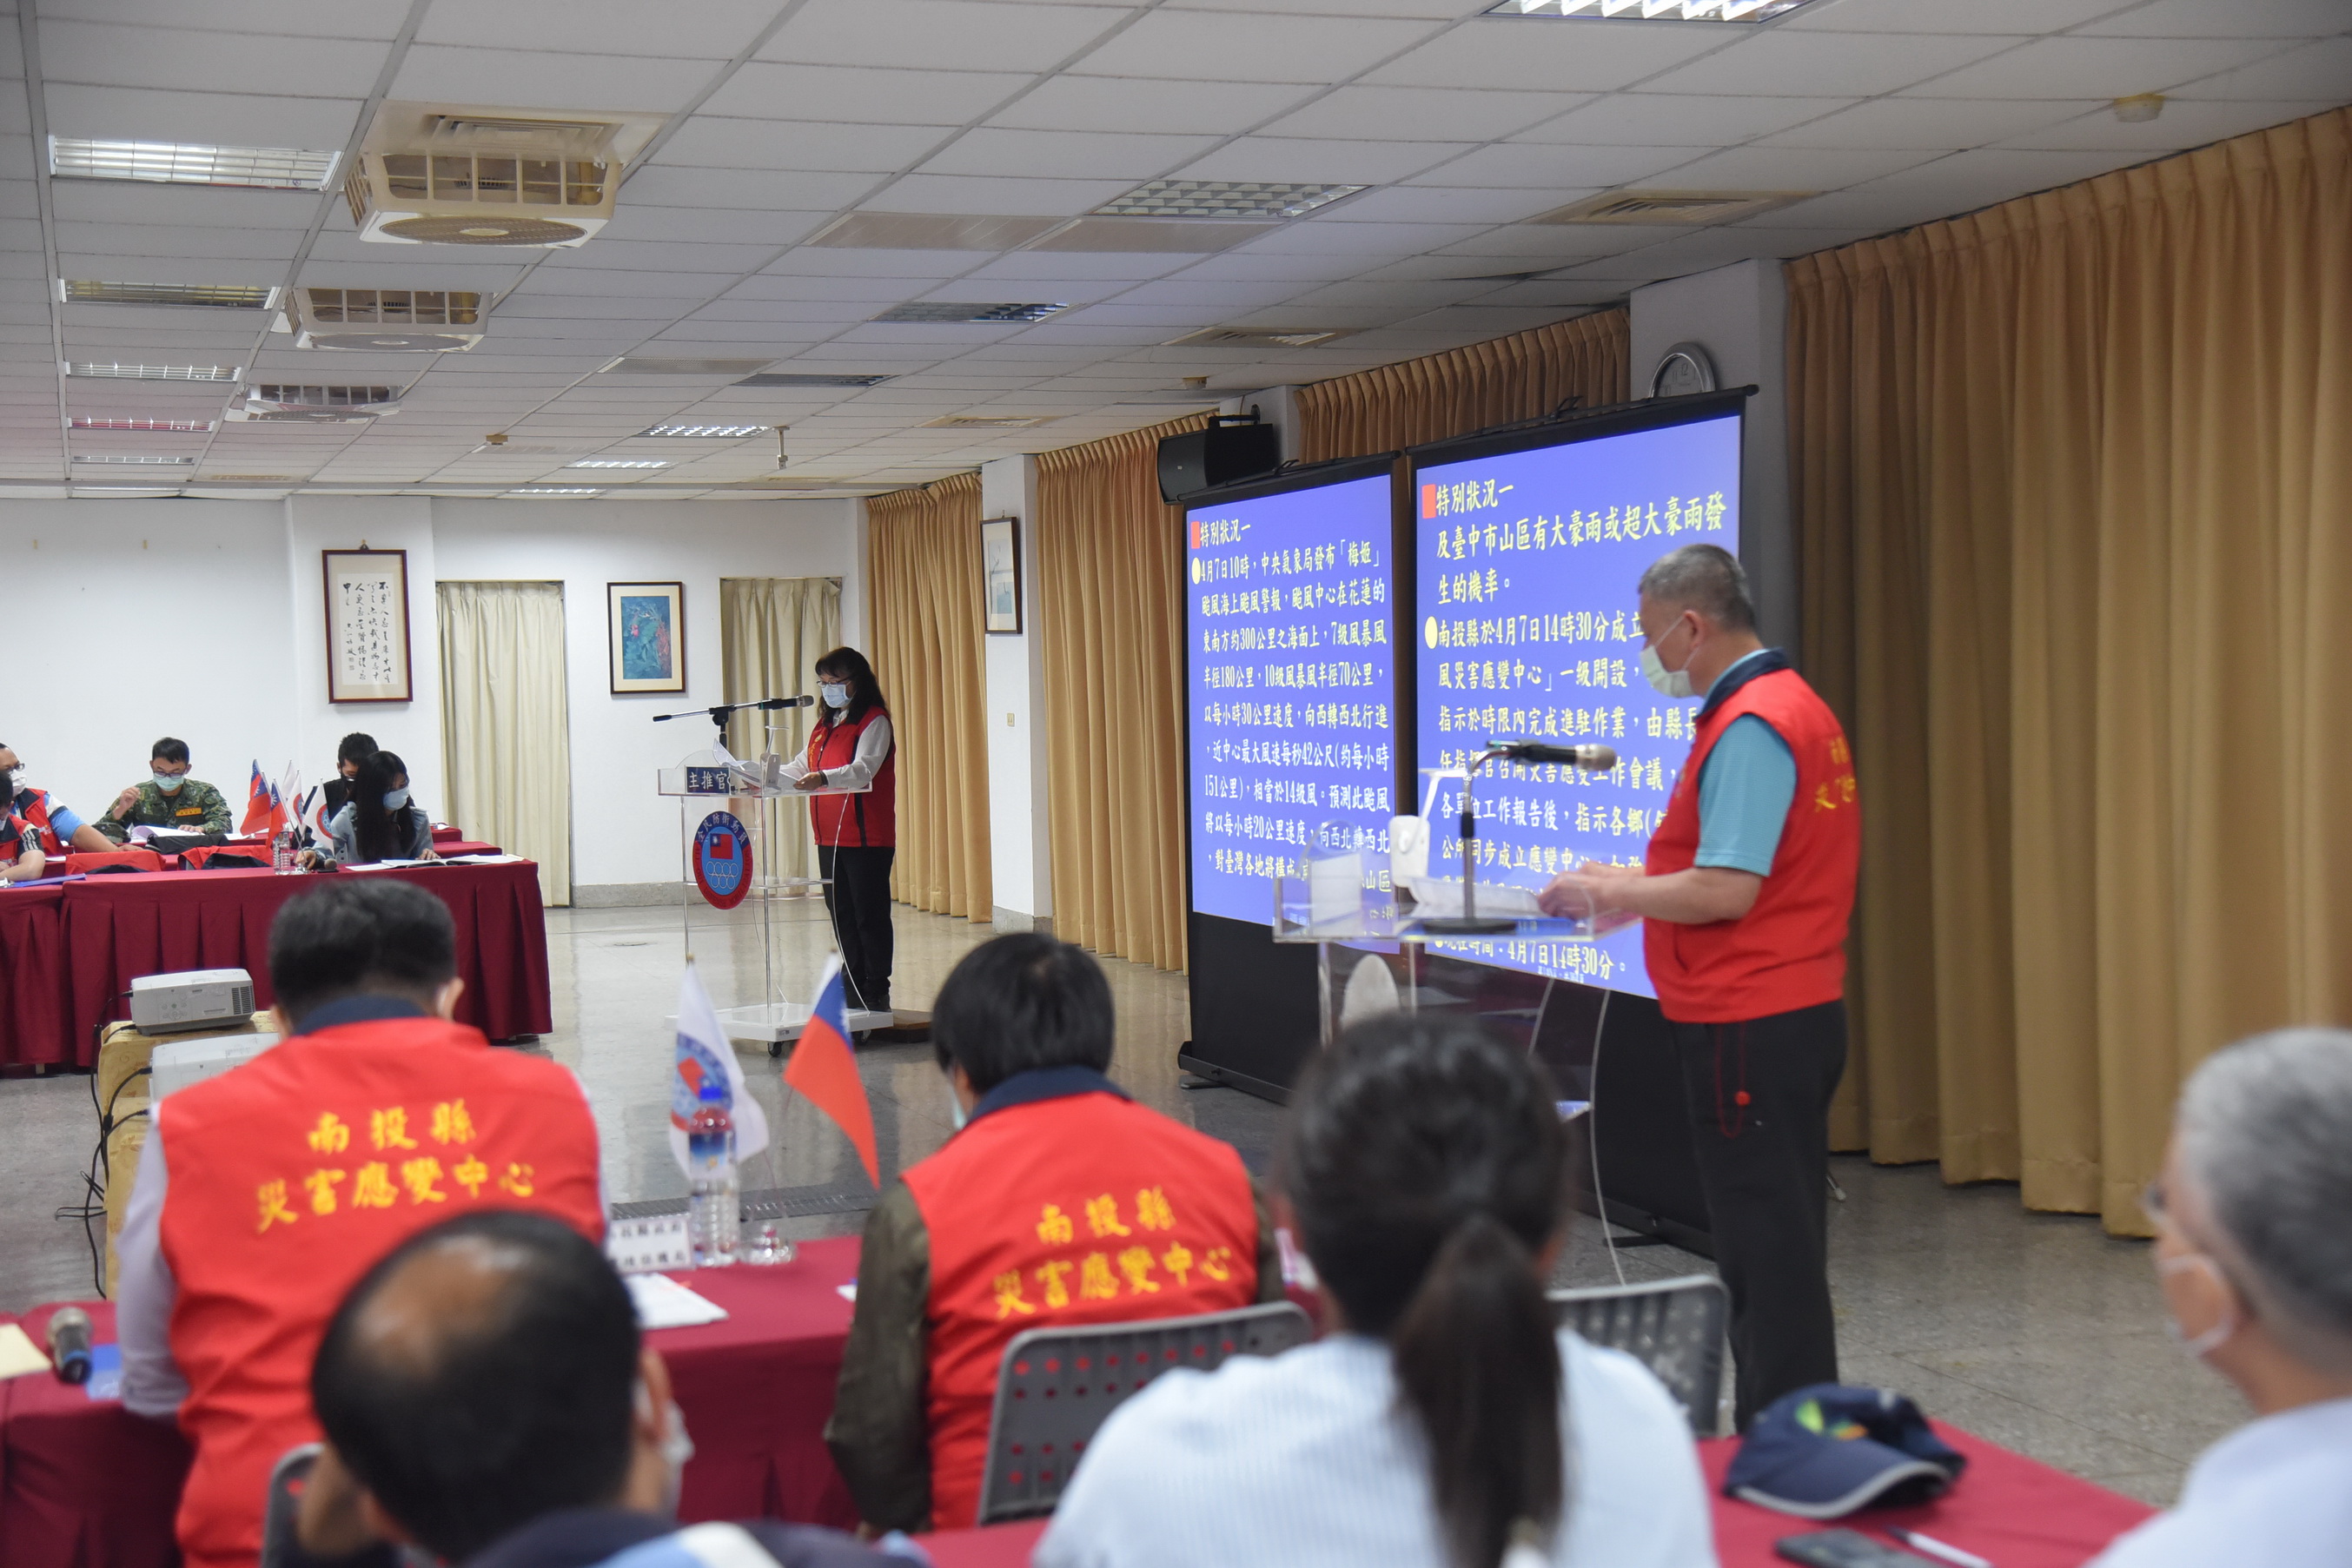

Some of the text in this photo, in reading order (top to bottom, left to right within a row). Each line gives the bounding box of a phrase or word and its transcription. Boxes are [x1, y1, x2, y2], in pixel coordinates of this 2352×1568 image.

[1435, 479, 1514, 517] 特別狀況一
[1200, 519, 1251, 548] 特別狀況一
[1436, 491, 1726, 561] 及臺中市山區有大豪雨或超大豪雨發
[1438, 568, 1510, 605] 生的機率。
[1438, 610, 1645, 649] 南投縣於4月7日14時30分成立
[689, 771, 727, 791] 主推官
[308, 1098, 476, 1154] 南投縣
